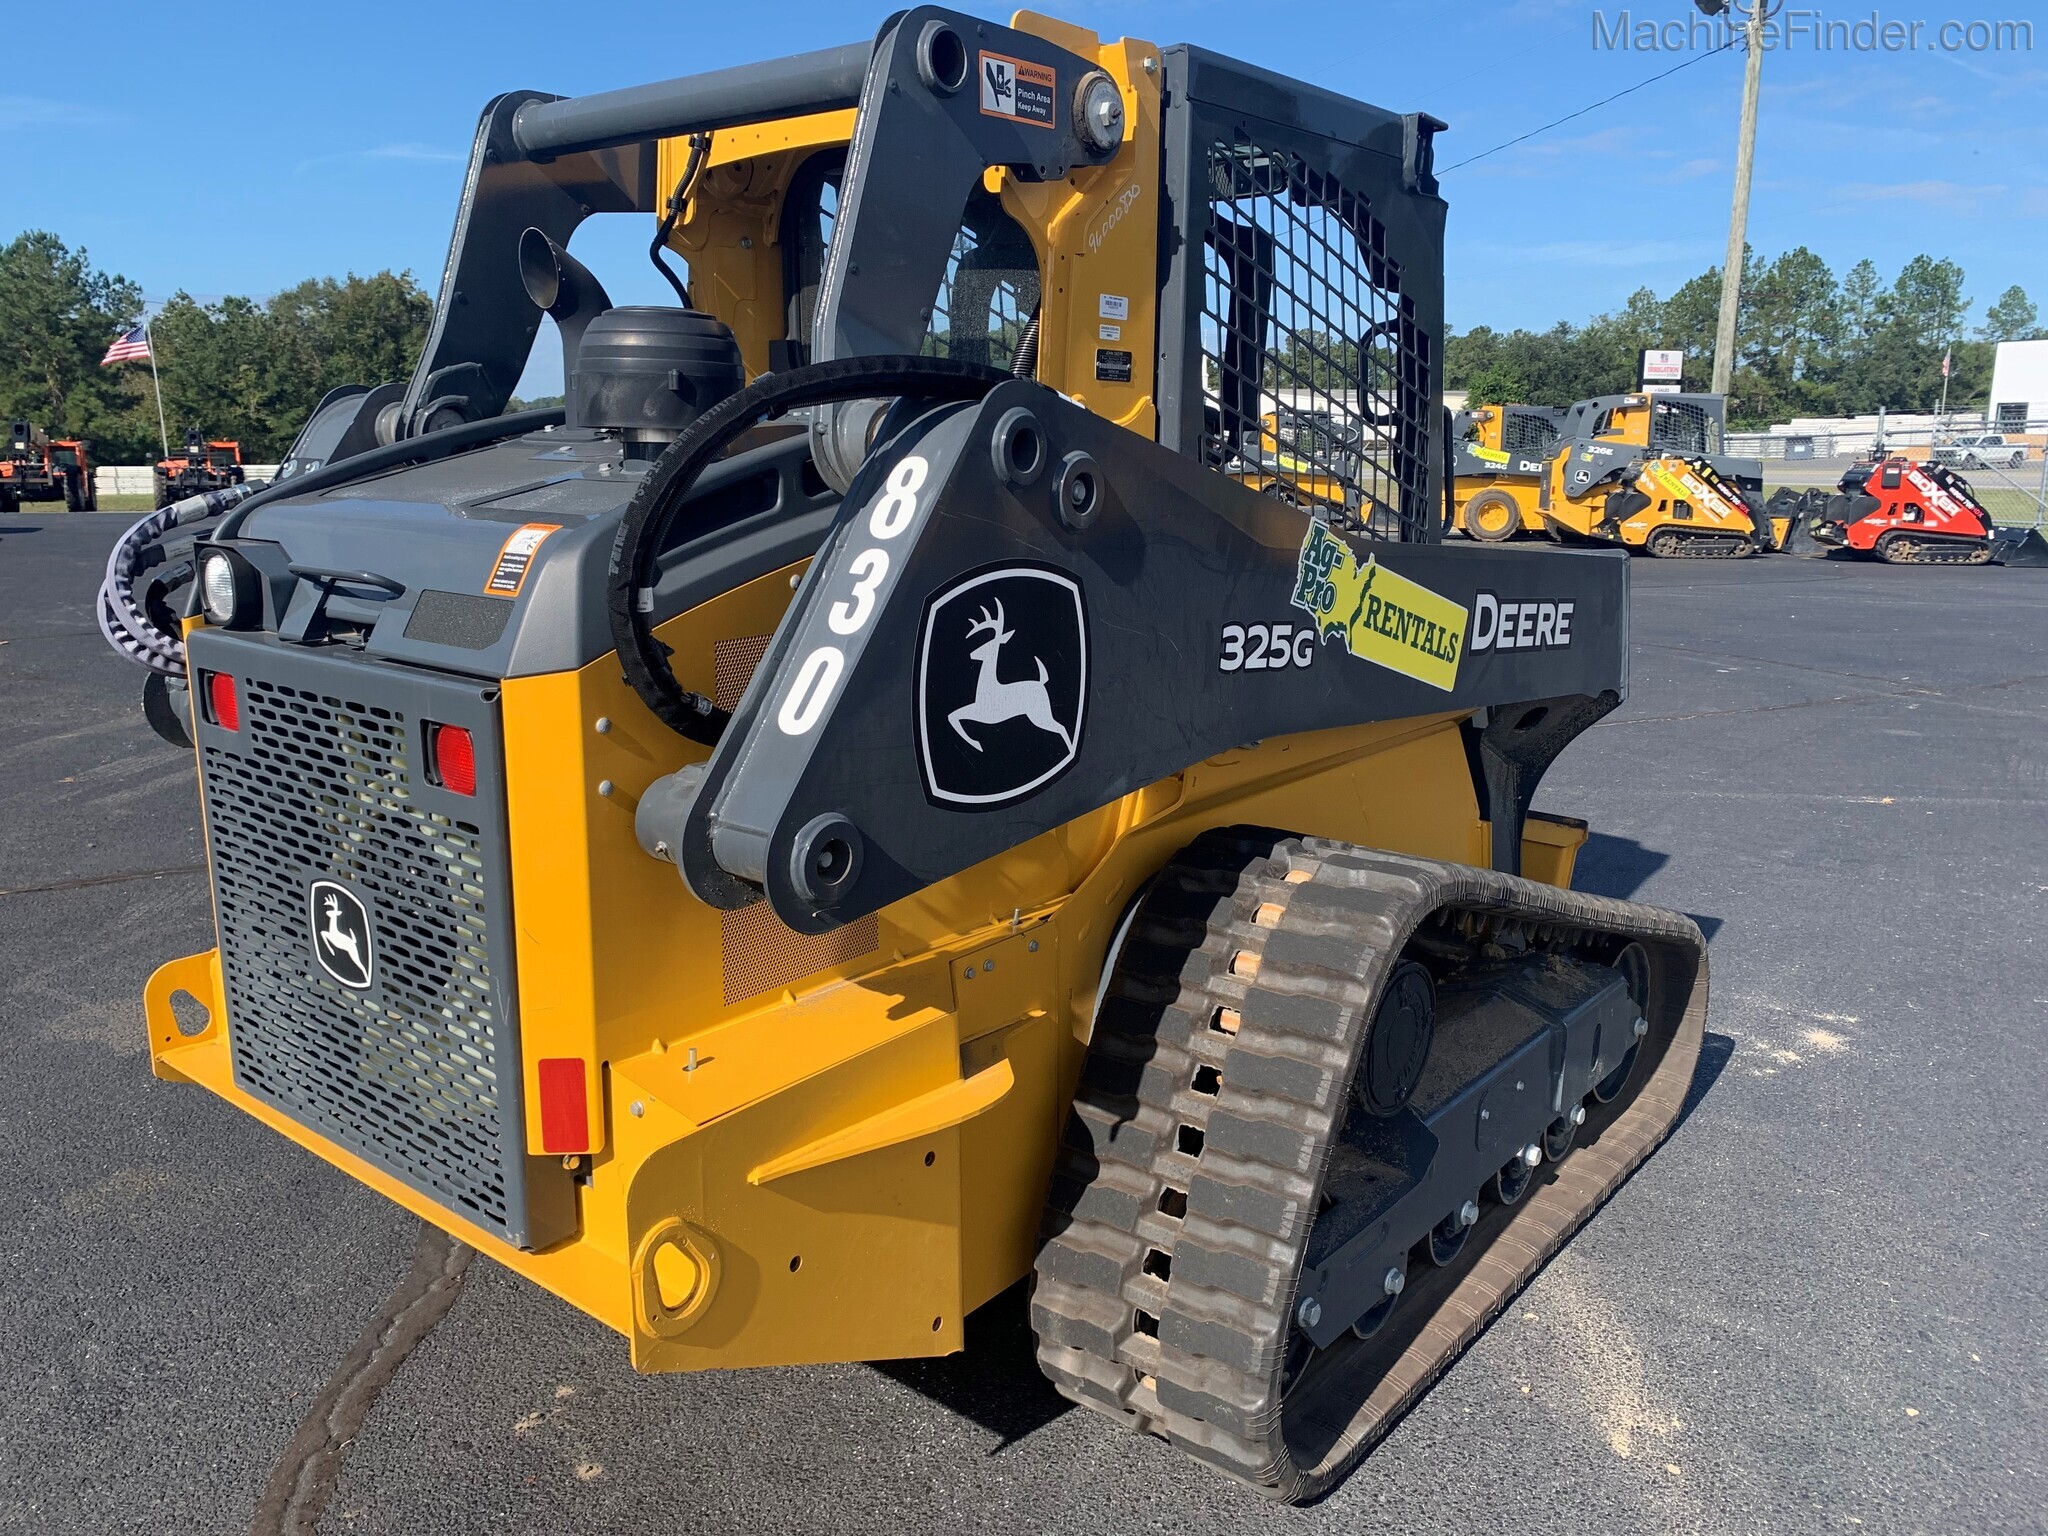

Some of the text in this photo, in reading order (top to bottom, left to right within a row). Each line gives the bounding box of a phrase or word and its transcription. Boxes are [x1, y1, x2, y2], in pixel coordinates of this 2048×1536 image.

[1017, 88, 1051, 104] Pinch Area
[1024, 67, 1052, 83] WARNING
[1017, 101, 1046, 116] Keep Away
[1088, 184, 1141, 254] 96000830
[1484, 461, 1507, 470] 324G
[1587, 446, 1614, 456] 326E
[1680, 472, 1733, 518] BOXER
[1907, 470, 1962, 517] BOXER
[1304, 525, 1344, 577] Ag-
[1297, 567, 1338, 614] Pro
[1363, 594, 1460, 664] RENTALS
[1471, 593, 1575, 651] DEERE
[1219, 624, 1317, 671] 325G
